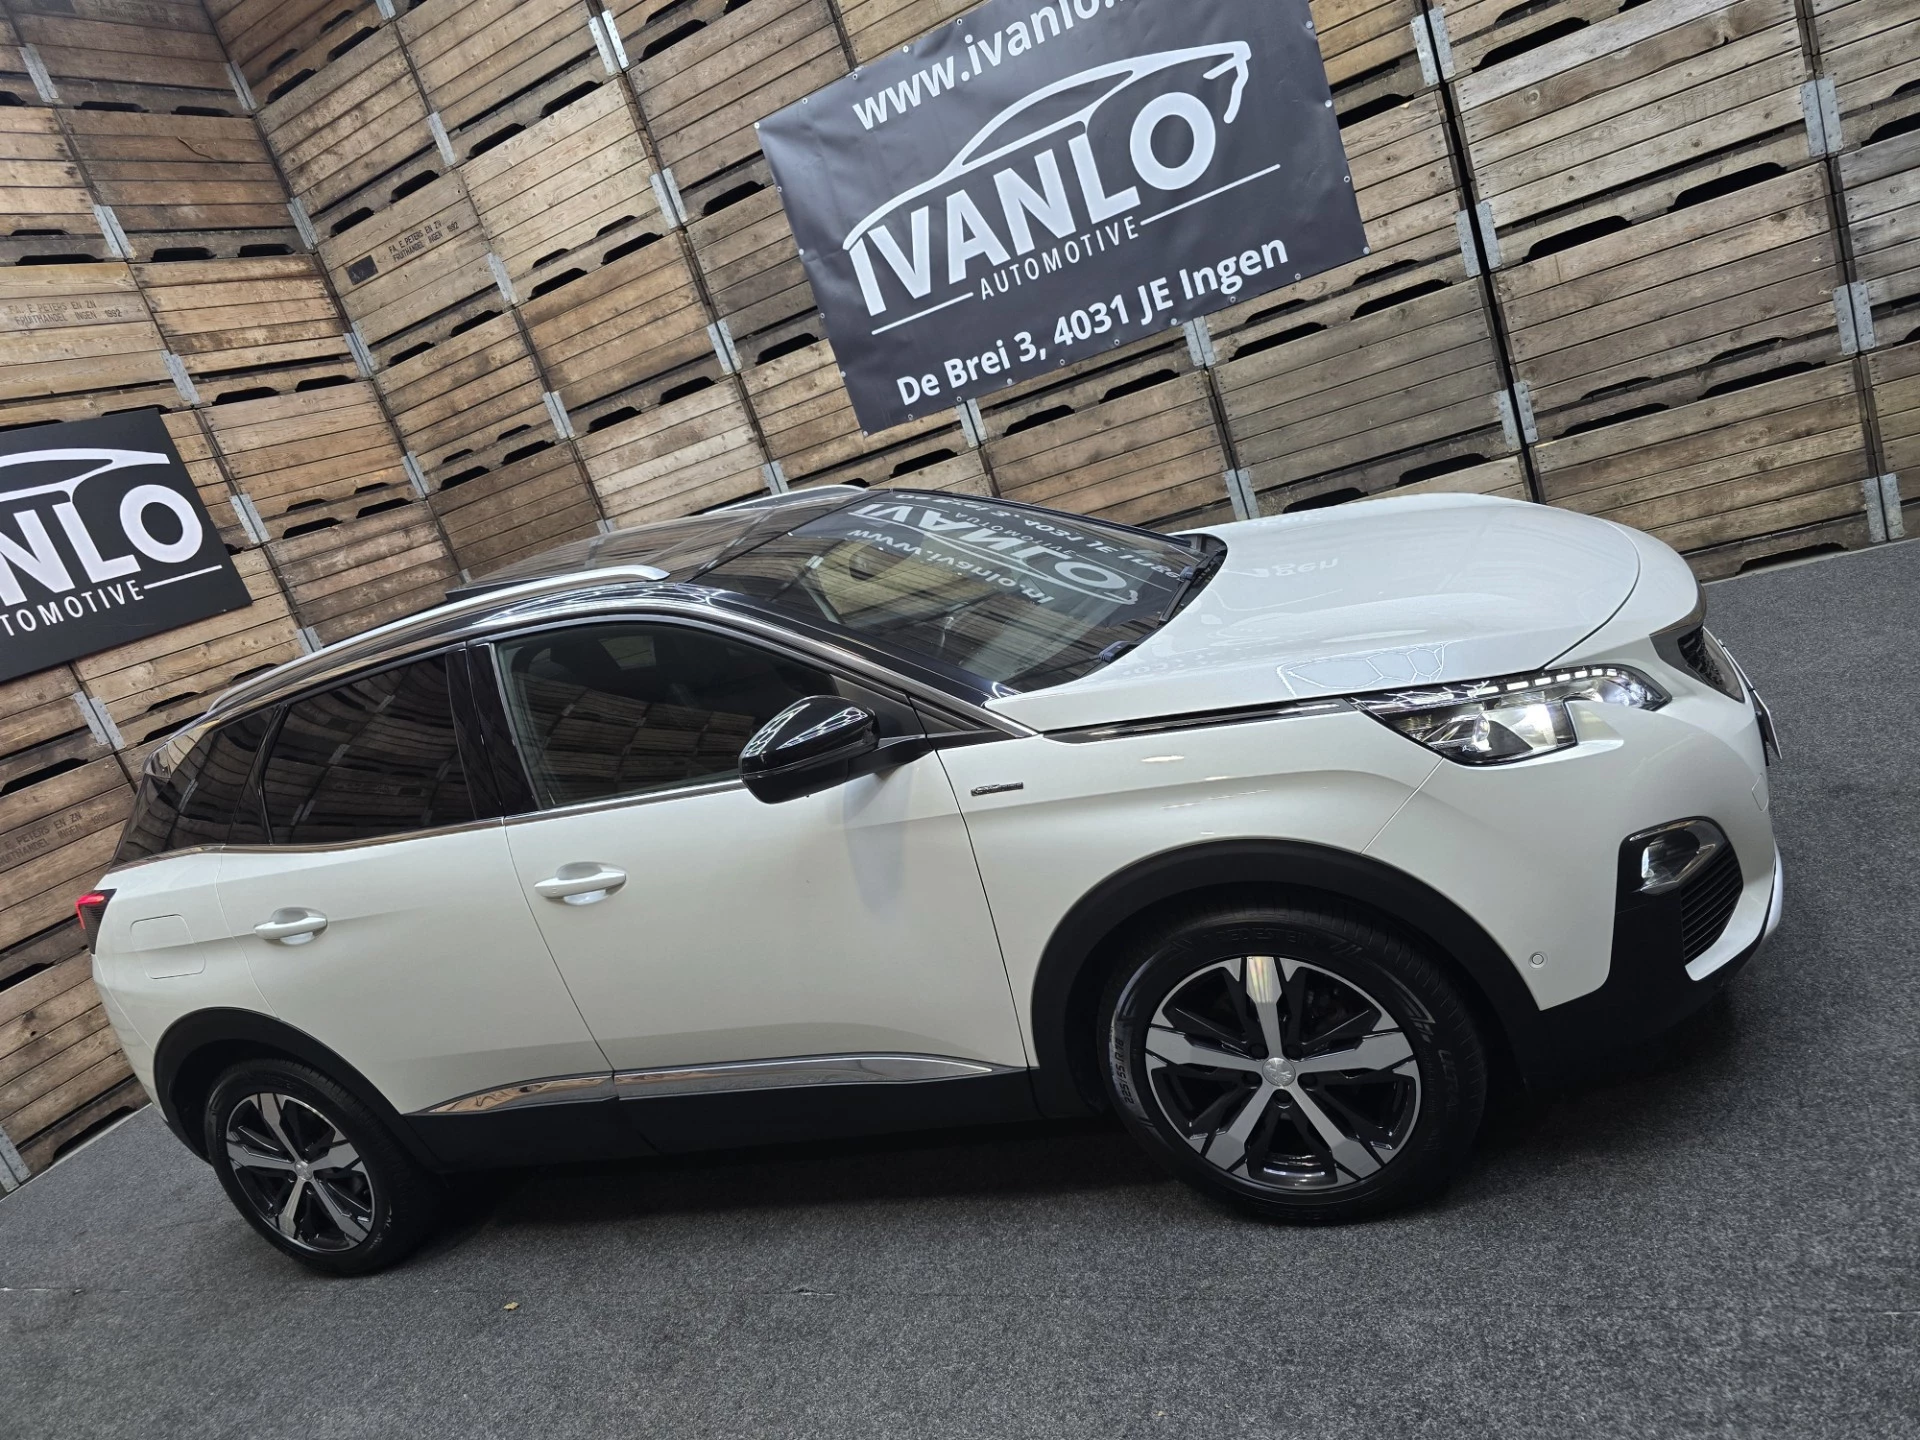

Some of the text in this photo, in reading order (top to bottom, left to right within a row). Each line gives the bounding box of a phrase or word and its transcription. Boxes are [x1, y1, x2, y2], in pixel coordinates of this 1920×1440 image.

[852, 0, 1124, 130] www.ivanlo.
[849, 92, 1216, 316] IVANLO
[980, 215, 1140, 301] AUTOMOTIVE
[896, 238, 1289, 406] De Brei 3, 4031 JE Ingen
